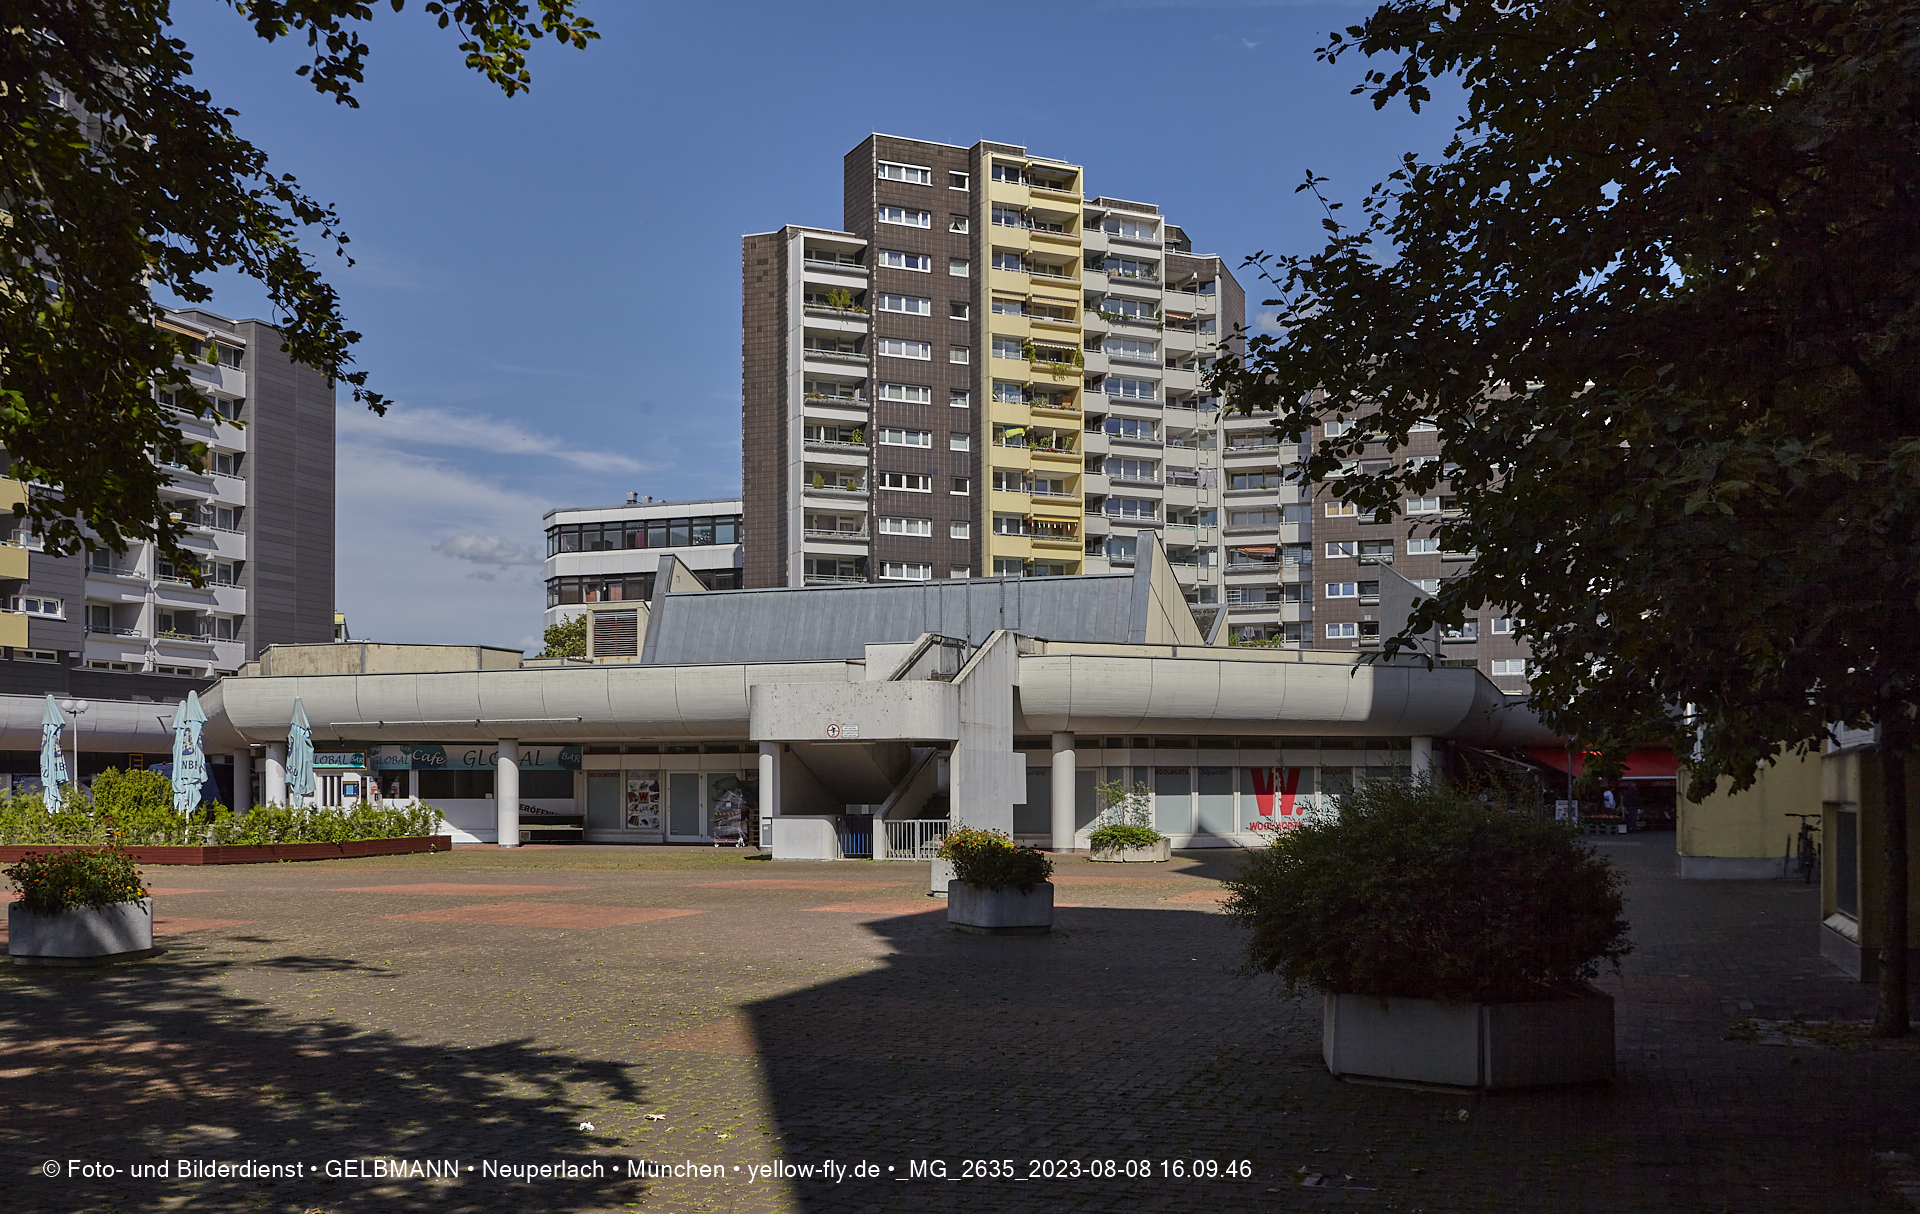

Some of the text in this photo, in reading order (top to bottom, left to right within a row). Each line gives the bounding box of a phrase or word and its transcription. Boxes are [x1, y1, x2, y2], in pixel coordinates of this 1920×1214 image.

[312, 754, 348, 765] LOBAL
[372, 755, 410, 765] GLOBAL
[412, 749, 447, 766] Cafe
[463, 750, 545, 767] GLOAL
[561, 752, 581, 763] BAR
